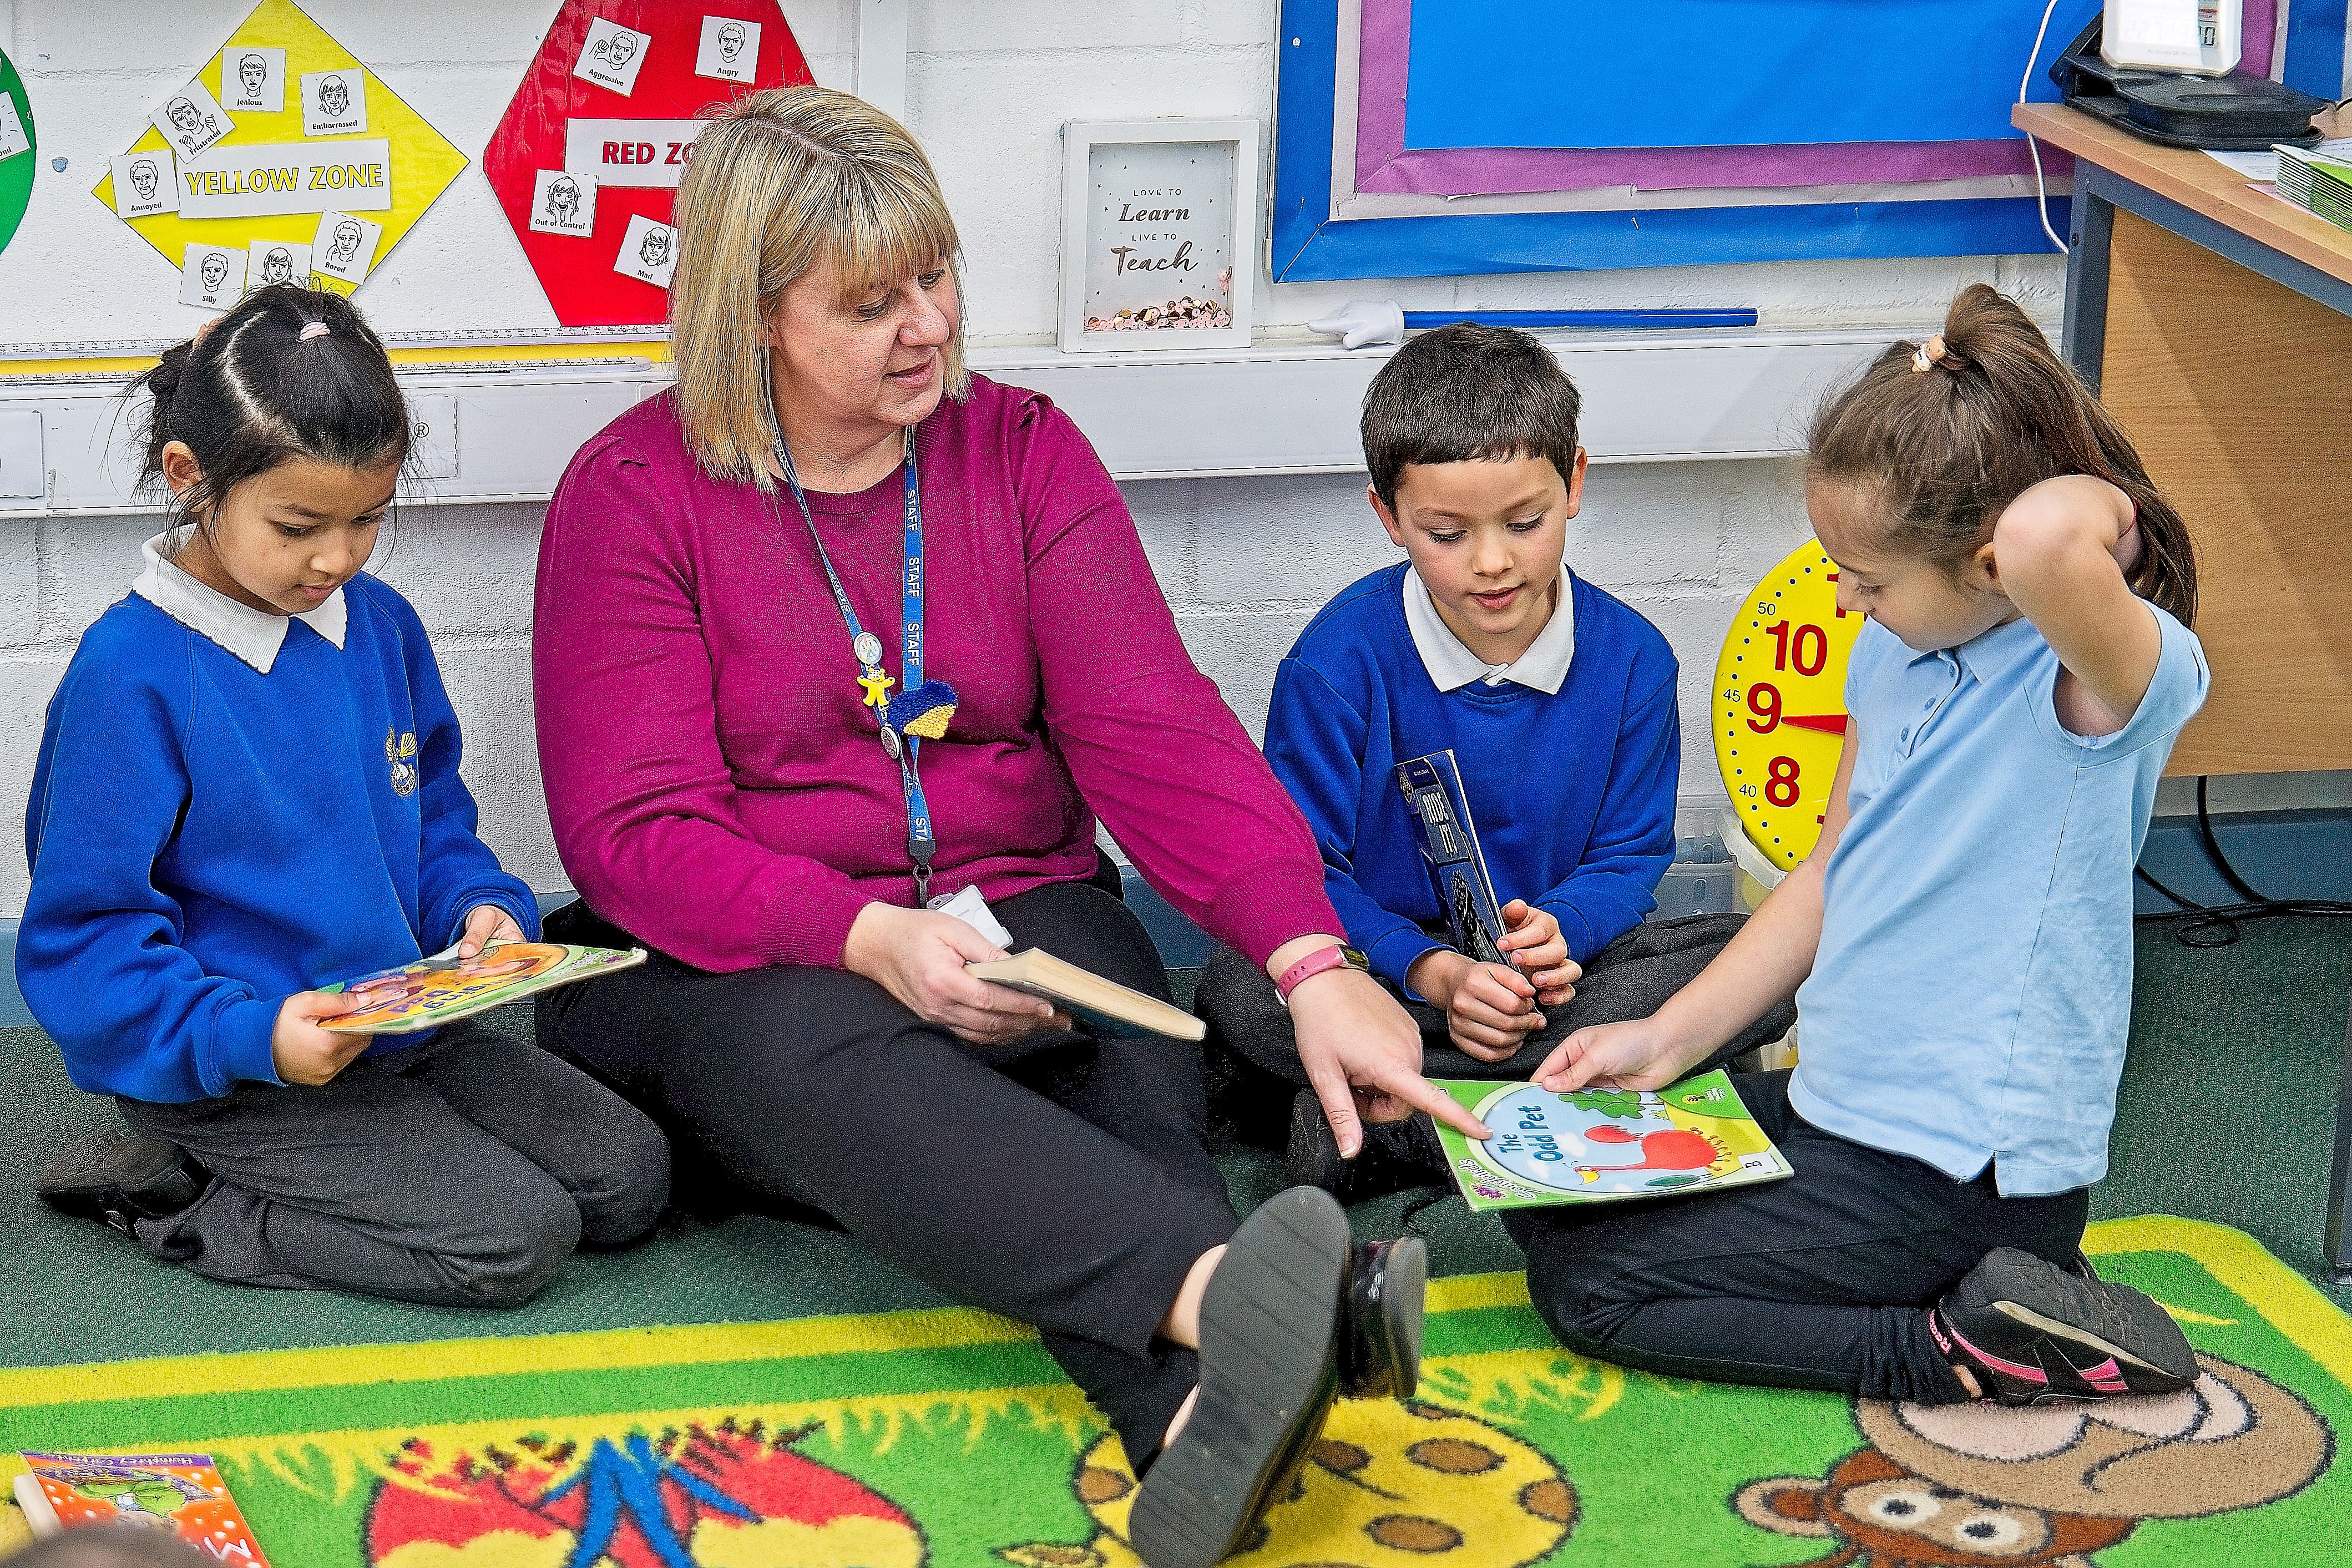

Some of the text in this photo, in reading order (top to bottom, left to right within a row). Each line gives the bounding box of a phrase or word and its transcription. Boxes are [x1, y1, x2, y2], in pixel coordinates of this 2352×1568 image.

[588, 67, 624, 87] Aggressive
[716, 66, 740, 79] Angry
[237, 98, 263, 107] Jealous
[312, 119, 358, 131] Embarrassed
[189, 130, 221, 155] Frustrated
[602, 141, 656, 165] RED
[184, 163, 384, 196] YELLOW ZONE
[131, 201, 163, 212] Annoyed
[1117, 203, 1191, 222] Learn
[559, 221, 586, 230] Control
[1110, 240, 1199, 276] Teach
[324, 262, 347, 274] Bored
[637, 269, 654, 280] Mad
[201, 295, 217, 305] Silly
[906, 488, 919, 532] STAFF
[908, 556, 920, 598] STAFF
[1757, 601, 1776, 616] 50
[907, 621, 919, 666] STAFF
[1766, 620, 1828, 677] 10
[1723, 689, 1741, 702] 45
[1746, 682, 1783, 735] 9
[1739, 783, 1757, 798] 40
[1764, 756, 1800, 808] 8
[1517, 1105, 1564, 1161] Odd Pet
[1496, 1133, 1524, 1153] The
[119, 1455, 194, 1466] Humphrey
